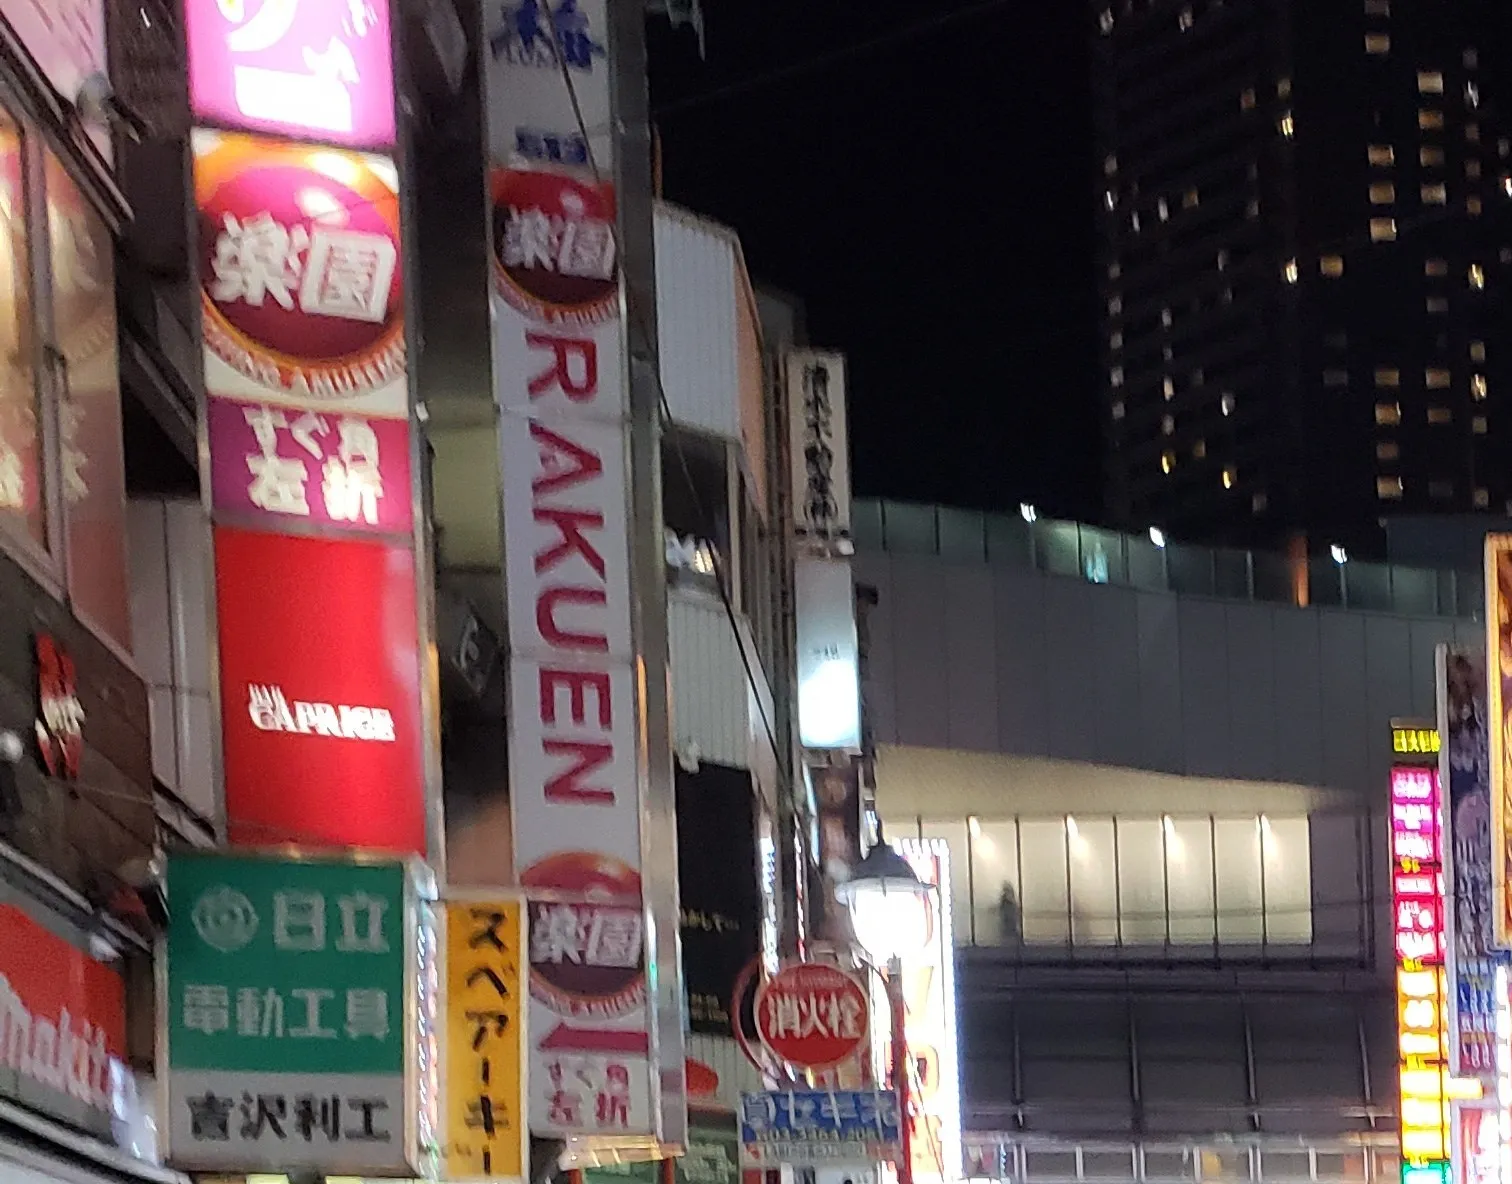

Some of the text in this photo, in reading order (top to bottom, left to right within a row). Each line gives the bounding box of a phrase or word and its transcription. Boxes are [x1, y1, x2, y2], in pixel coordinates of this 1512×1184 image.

[211, 211, 397, 323] 楽園
[502, 206, 616, 280] 楽園
[526, 327, 616, 805] RAKUEN
[273, 891, 390, 953] 日立
[530, 902, 641, 968] 楽園
[183, 984, 390, 1041] 電動工具
[766, 990, 862, 1041] 消火栓
